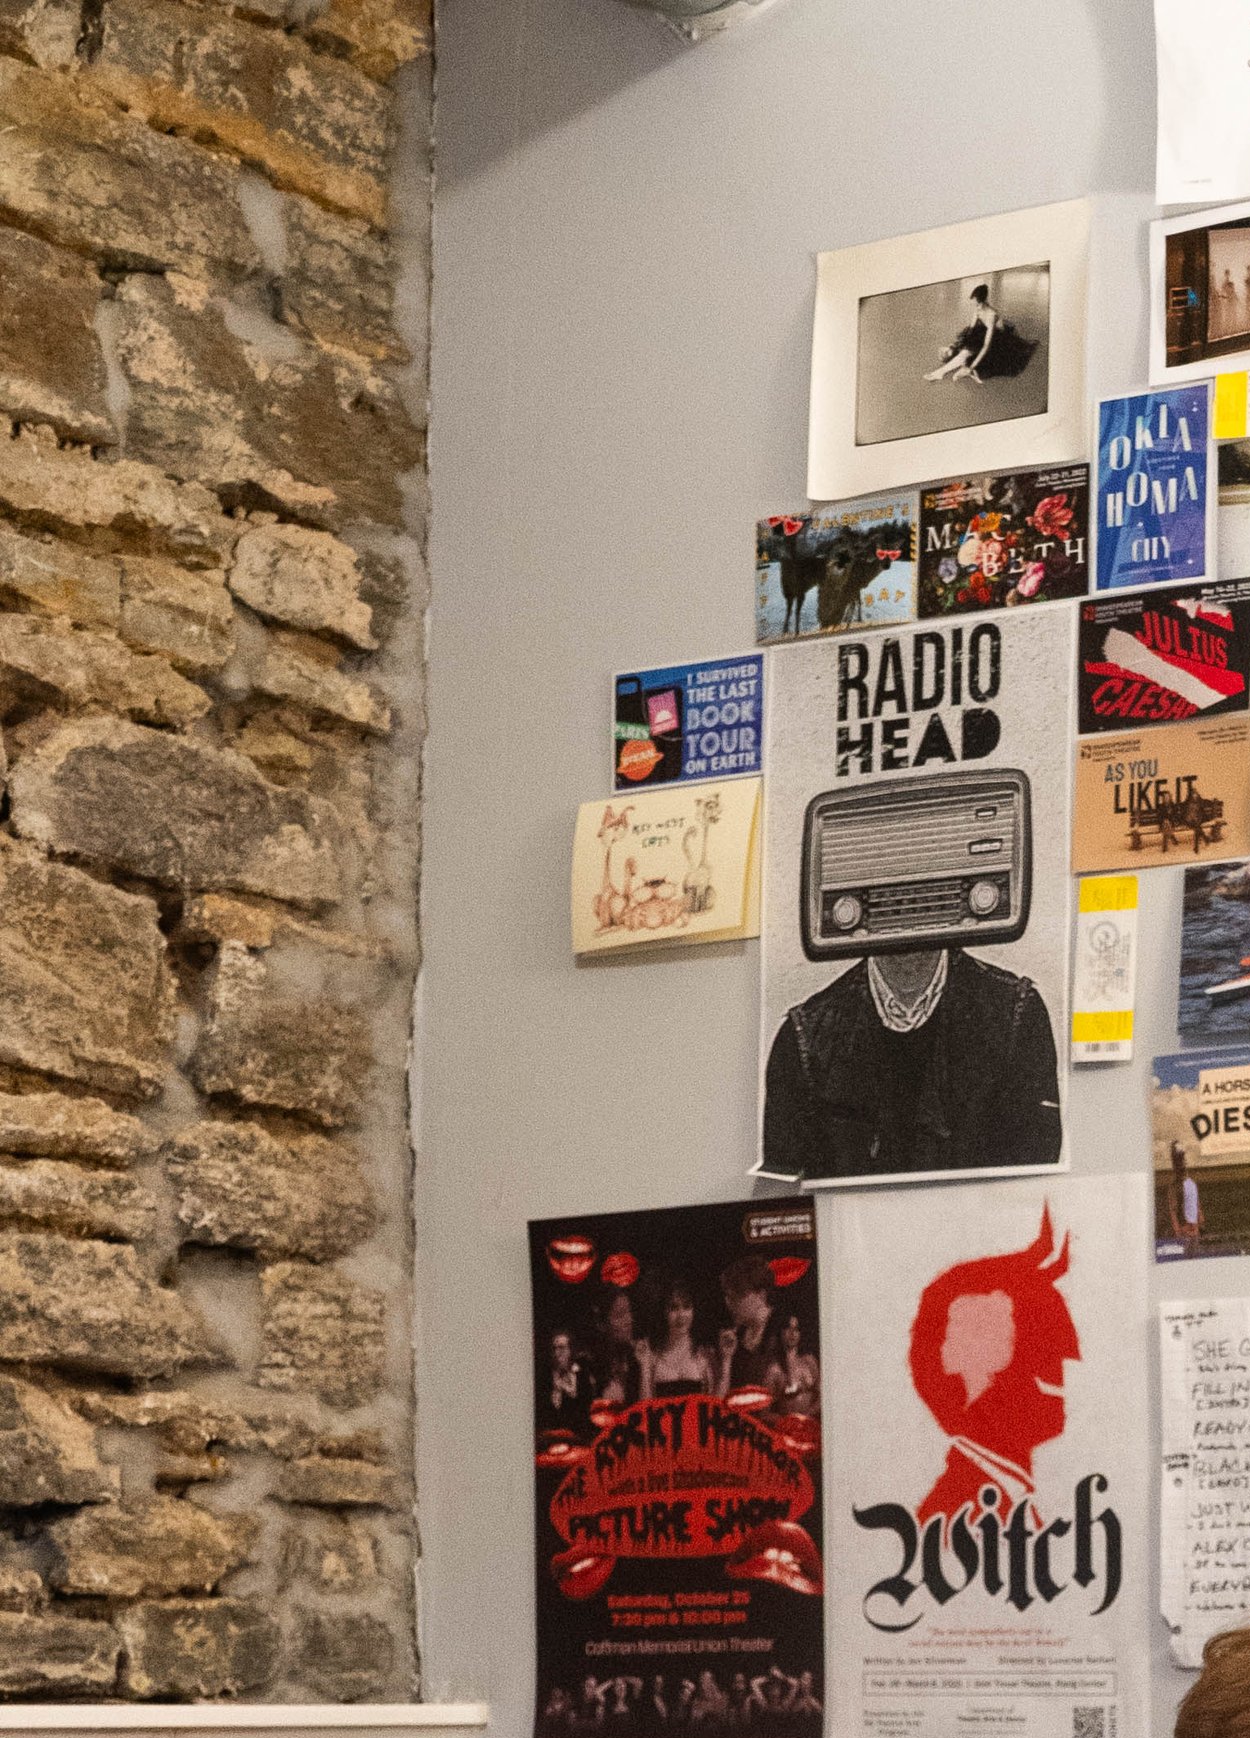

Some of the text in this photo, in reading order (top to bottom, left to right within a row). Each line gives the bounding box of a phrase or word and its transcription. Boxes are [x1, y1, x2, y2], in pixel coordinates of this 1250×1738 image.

[1134, 610, 1229, 671] JULIUS
[836, 622, 1002, 723] RADIO
[687, 680, 758, 704] THE LAST
[1091, 678, 1199, 719] CAESAR
[687, 700, 756, 731] BOOK
[687, 726, 757, 759] TOUR
[836, 707, 1002, 778] HEAD
[685, 759, 709, 775] ON
[1104, 758, 1159, 784] AS YOU
[1113, 778, 1170, 815] LIKE
[1202, 1083, 1212, 1096] A
[1193, 1338, 1232, 1361] SHE
[1191, 1382, 1226, 1401] FILL
[1228, 1379, 1250, 1397] IN
[595, 1402, 800, 1486] ROCKY HORROR
[568, 1497, 791, 1545] PICTURE SHOW
[1190, 1500, 1235, 1519] JUST
[850, 1473, 1123, 1634] Witch
[1191, 1538, 1239, 1557] ALEX
